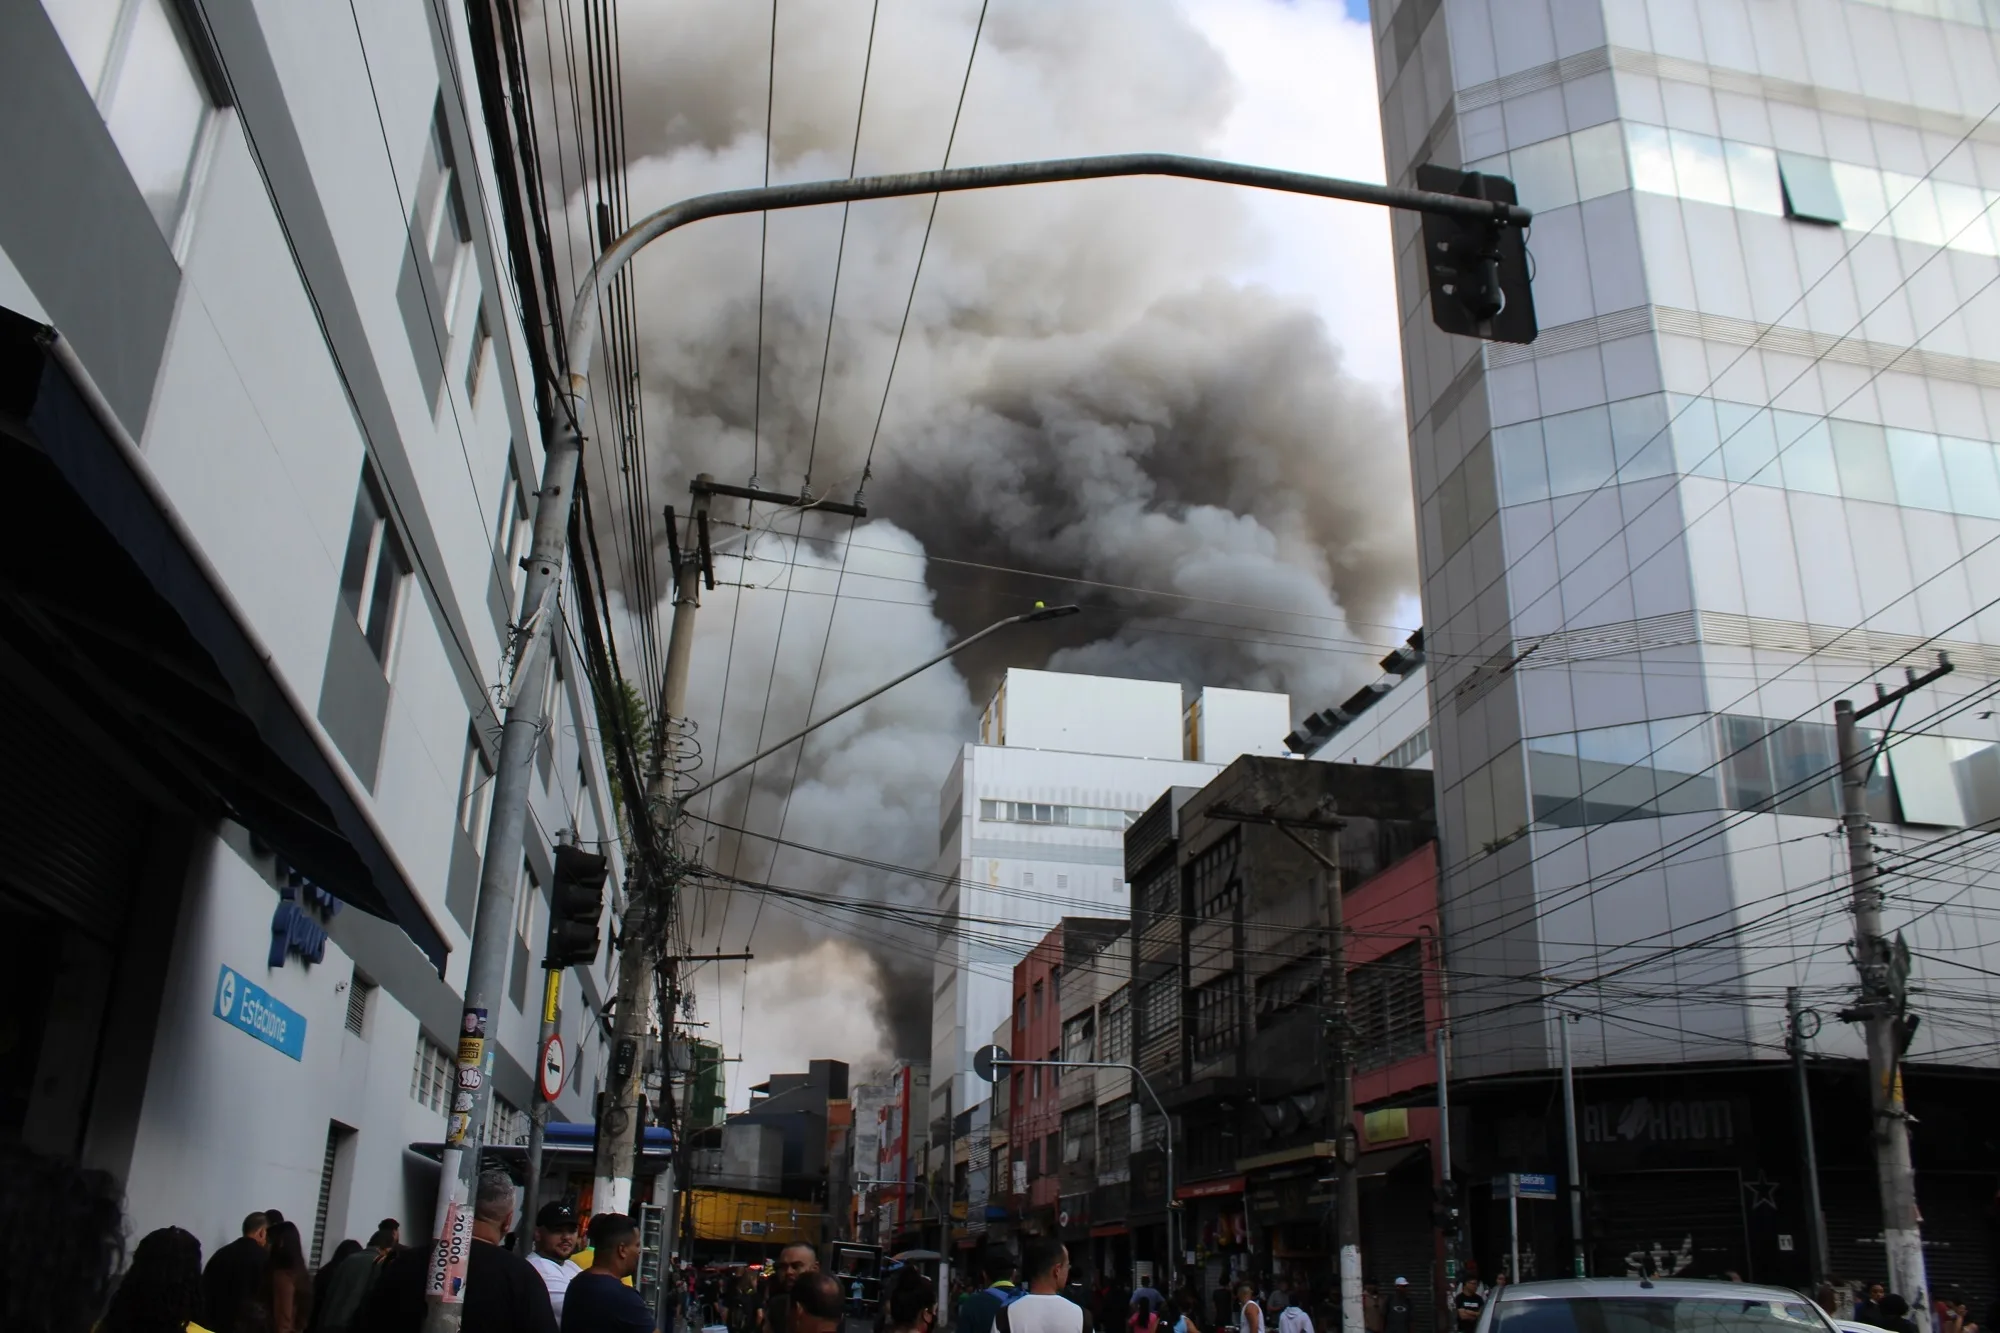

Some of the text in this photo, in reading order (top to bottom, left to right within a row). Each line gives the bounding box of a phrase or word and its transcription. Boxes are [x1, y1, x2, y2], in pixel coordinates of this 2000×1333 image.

[239, 986, 287, 1043] Estacione
[434, 1238, 450, 1291] 20.000
[448, 1213, 465, 1265] 20.000
